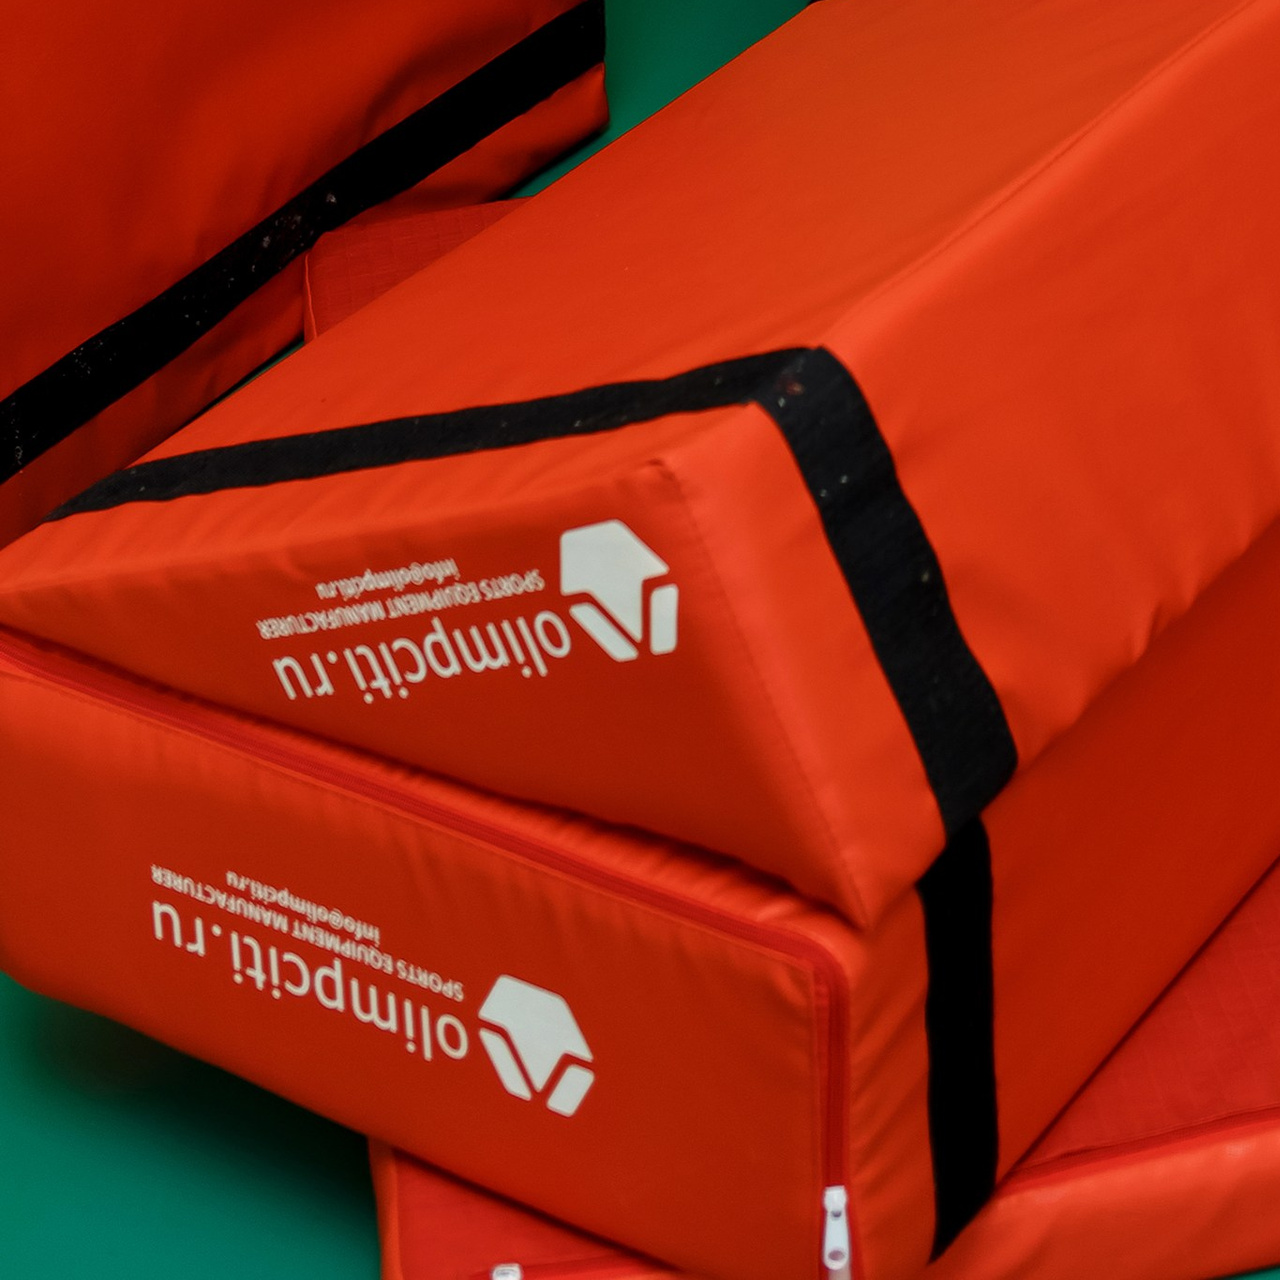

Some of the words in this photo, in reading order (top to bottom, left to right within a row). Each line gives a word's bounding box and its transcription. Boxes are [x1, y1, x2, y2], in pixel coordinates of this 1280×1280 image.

[315, 558, 459, 601] info@olimpciti.ru
[388, 586, 481, 619] EQUIPMENT
[480, 568, 546, 601] SPORTS
[255, 603, 386, 640] MANUFACTURER
[272, 610, 572, 704] olimpciti.ru
[150, 864, 289, 934] MANUFACTURER
[225, 869, 381, 946] info@olimpciti.ru
[293, 923, 393, 976] EQUIPMENT
[152, 900, 470, 1062] olimpciti.ru
[397, 958, 465, 1002] SPORTS
